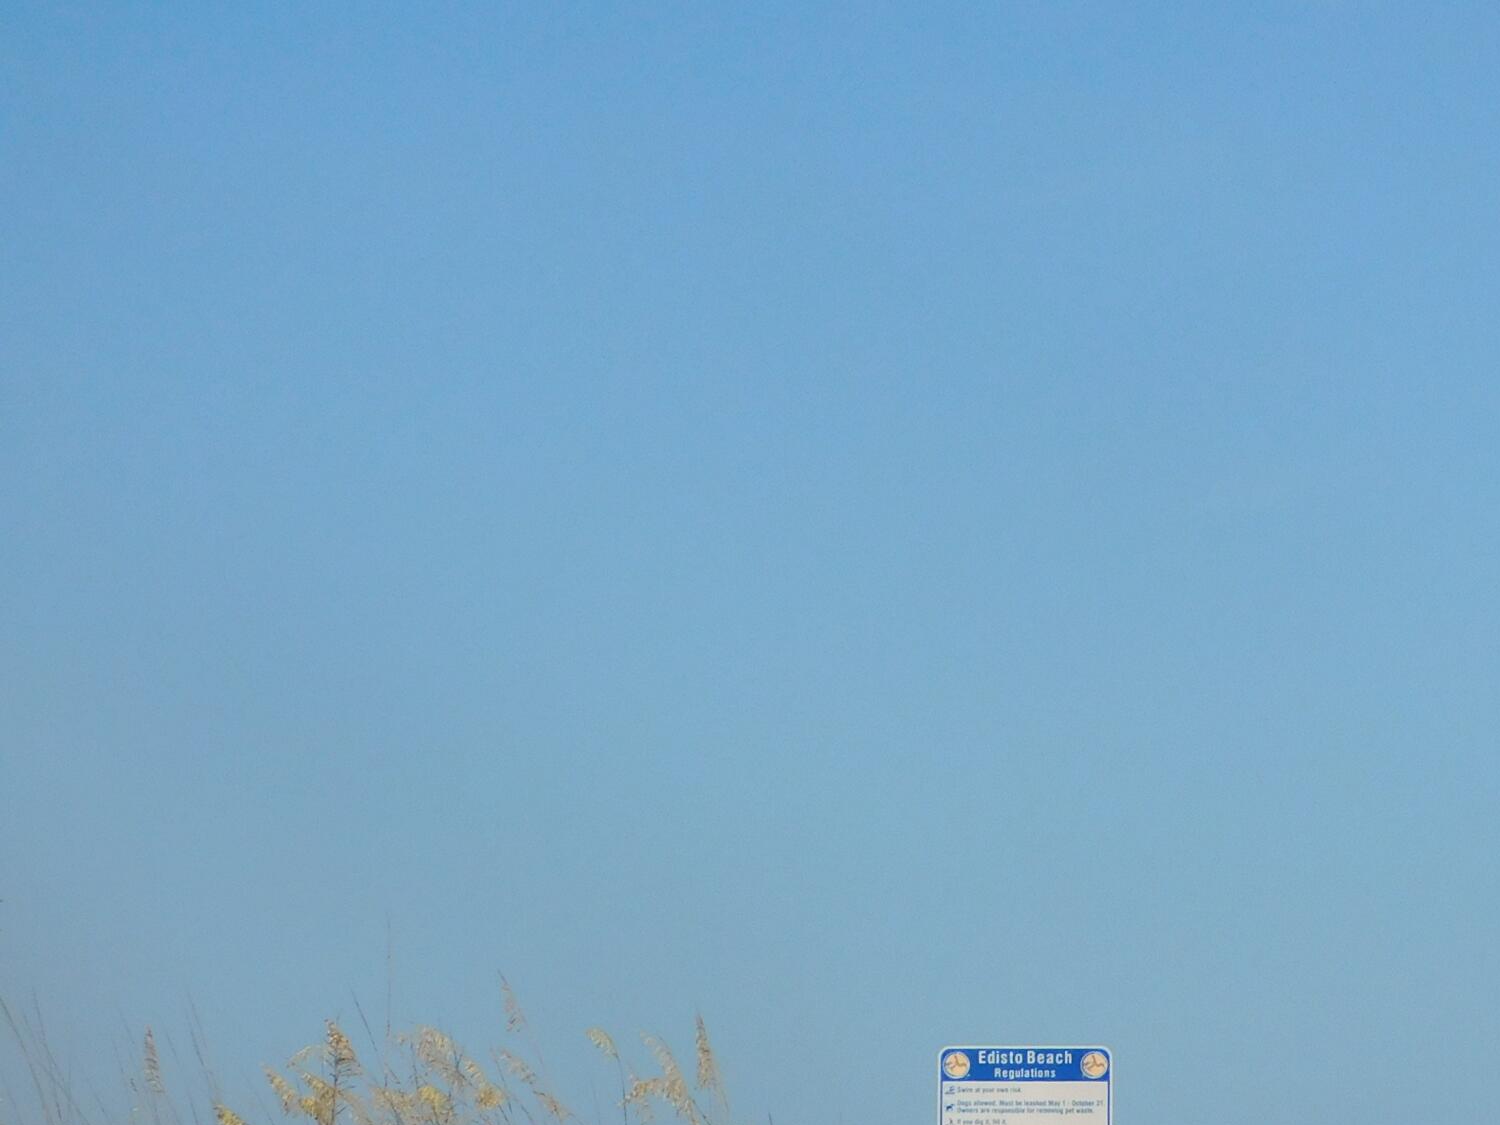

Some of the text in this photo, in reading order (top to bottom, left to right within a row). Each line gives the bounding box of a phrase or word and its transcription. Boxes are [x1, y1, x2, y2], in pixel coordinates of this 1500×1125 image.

[978, 1051, 1072, 1064] Edisto Beach
[994, 1068, 1056, 1079] Regulations
